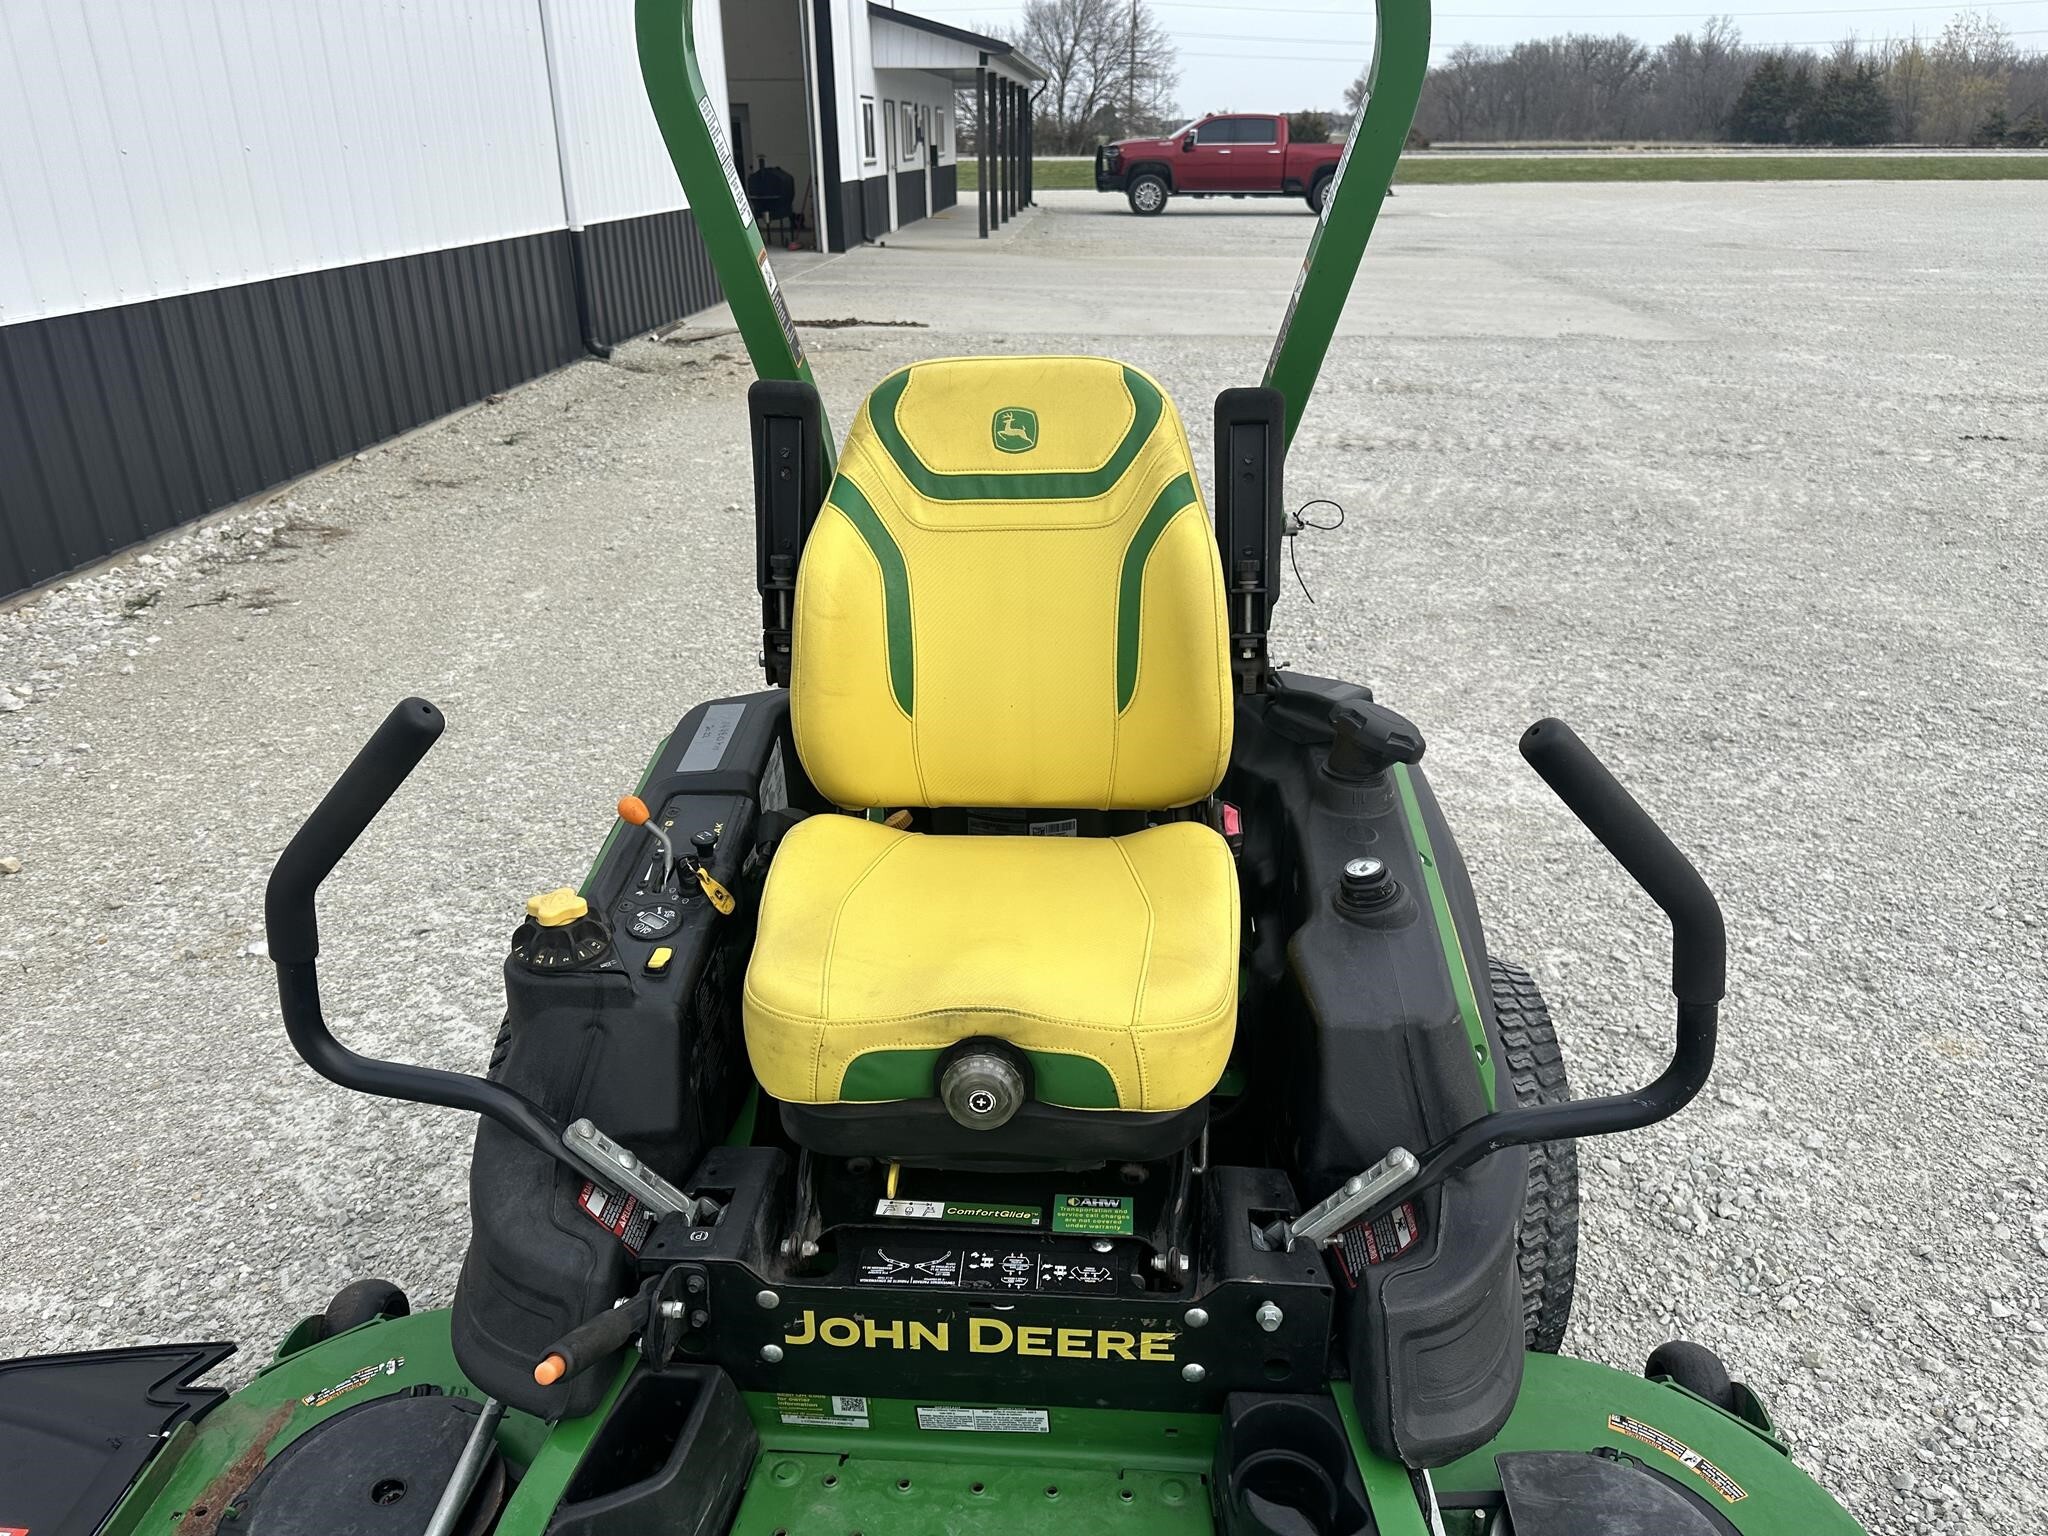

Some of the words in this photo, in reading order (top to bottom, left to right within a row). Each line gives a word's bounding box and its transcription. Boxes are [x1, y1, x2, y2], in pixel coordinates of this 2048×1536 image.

[1080, 1198, 1120, 1207] AHW
[784, 1310, 949, 1352] JOHN
[969, 1317, 1178, 1362] DEERE
